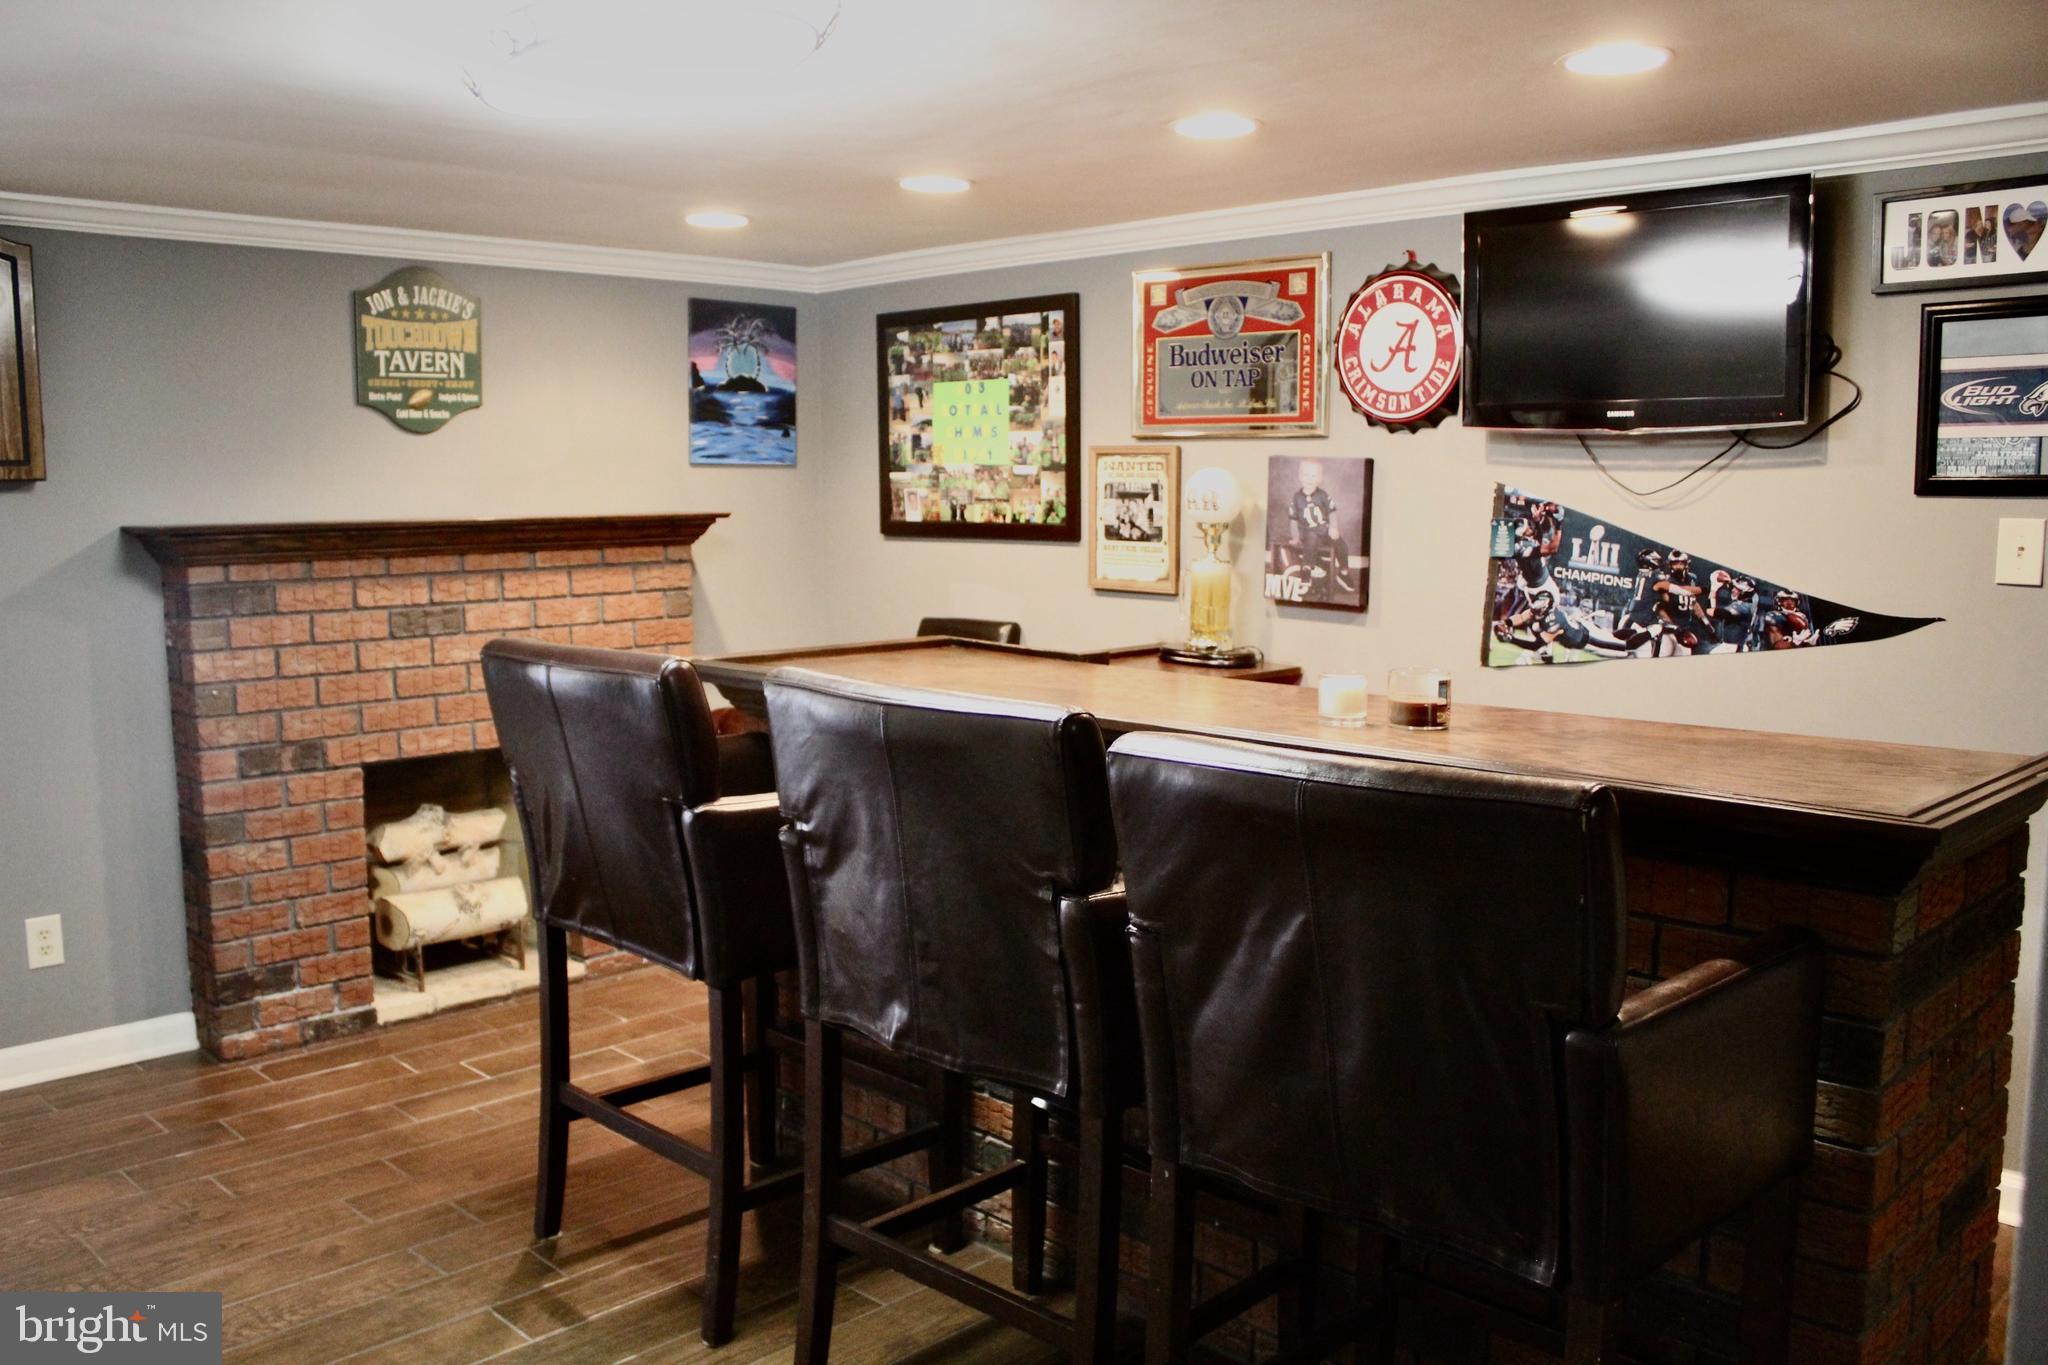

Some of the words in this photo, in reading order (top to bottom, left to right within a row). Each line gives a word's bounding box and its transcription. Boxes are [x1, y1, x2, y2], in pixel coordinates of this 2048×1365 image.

[1891, 205, 1999, 271] JON
[365, 289, 395, 316] JON
[397, 286, 409, 306] &
[413, 285, 477, 320] JACKIE'S
[1348, 283, 1453, 340] ALABAMA
[374, 350, 466, 378] TAVERN
[1168, 340, 1286, 368] Budweiser
[1190, 369, 1219, 389] ON
[1221, 367, 1262, 388] TAP
[1345, 356, 1411, 411] CRIMSON
[1413, 357, 1452, 403] TIDE
[1963, 385, 2017, 396] BUD
[1952, 395, 2021, 407] LIGHT
[1264, 573, 1310, 602] MVP
[1553, 566, 1633, 590] CHAMPIONS
